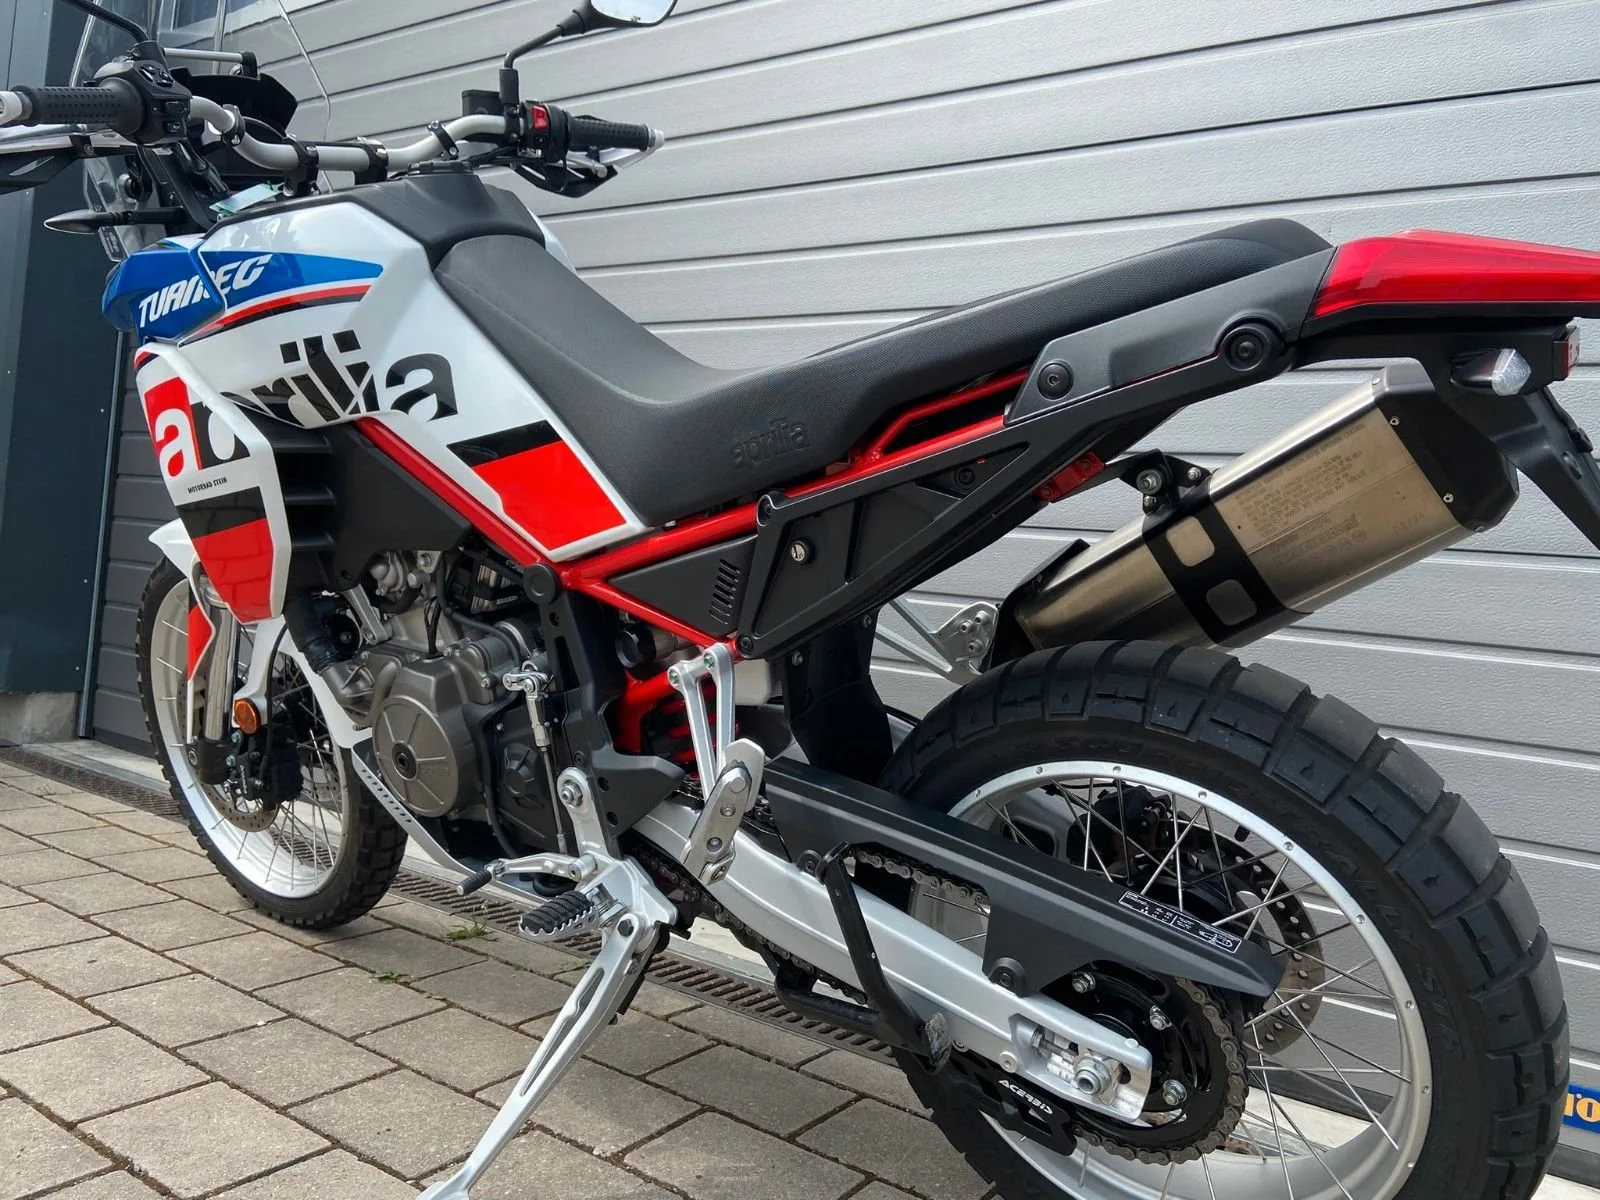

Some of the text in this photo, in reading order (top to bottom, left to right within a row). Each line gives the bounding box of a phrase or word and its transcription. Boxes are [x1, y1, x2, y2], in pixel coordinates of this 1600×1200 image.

[187, 477, 227, 494] MOTORRAD STEIN
[998, 1079, 1053, 1115] ACERBIS
